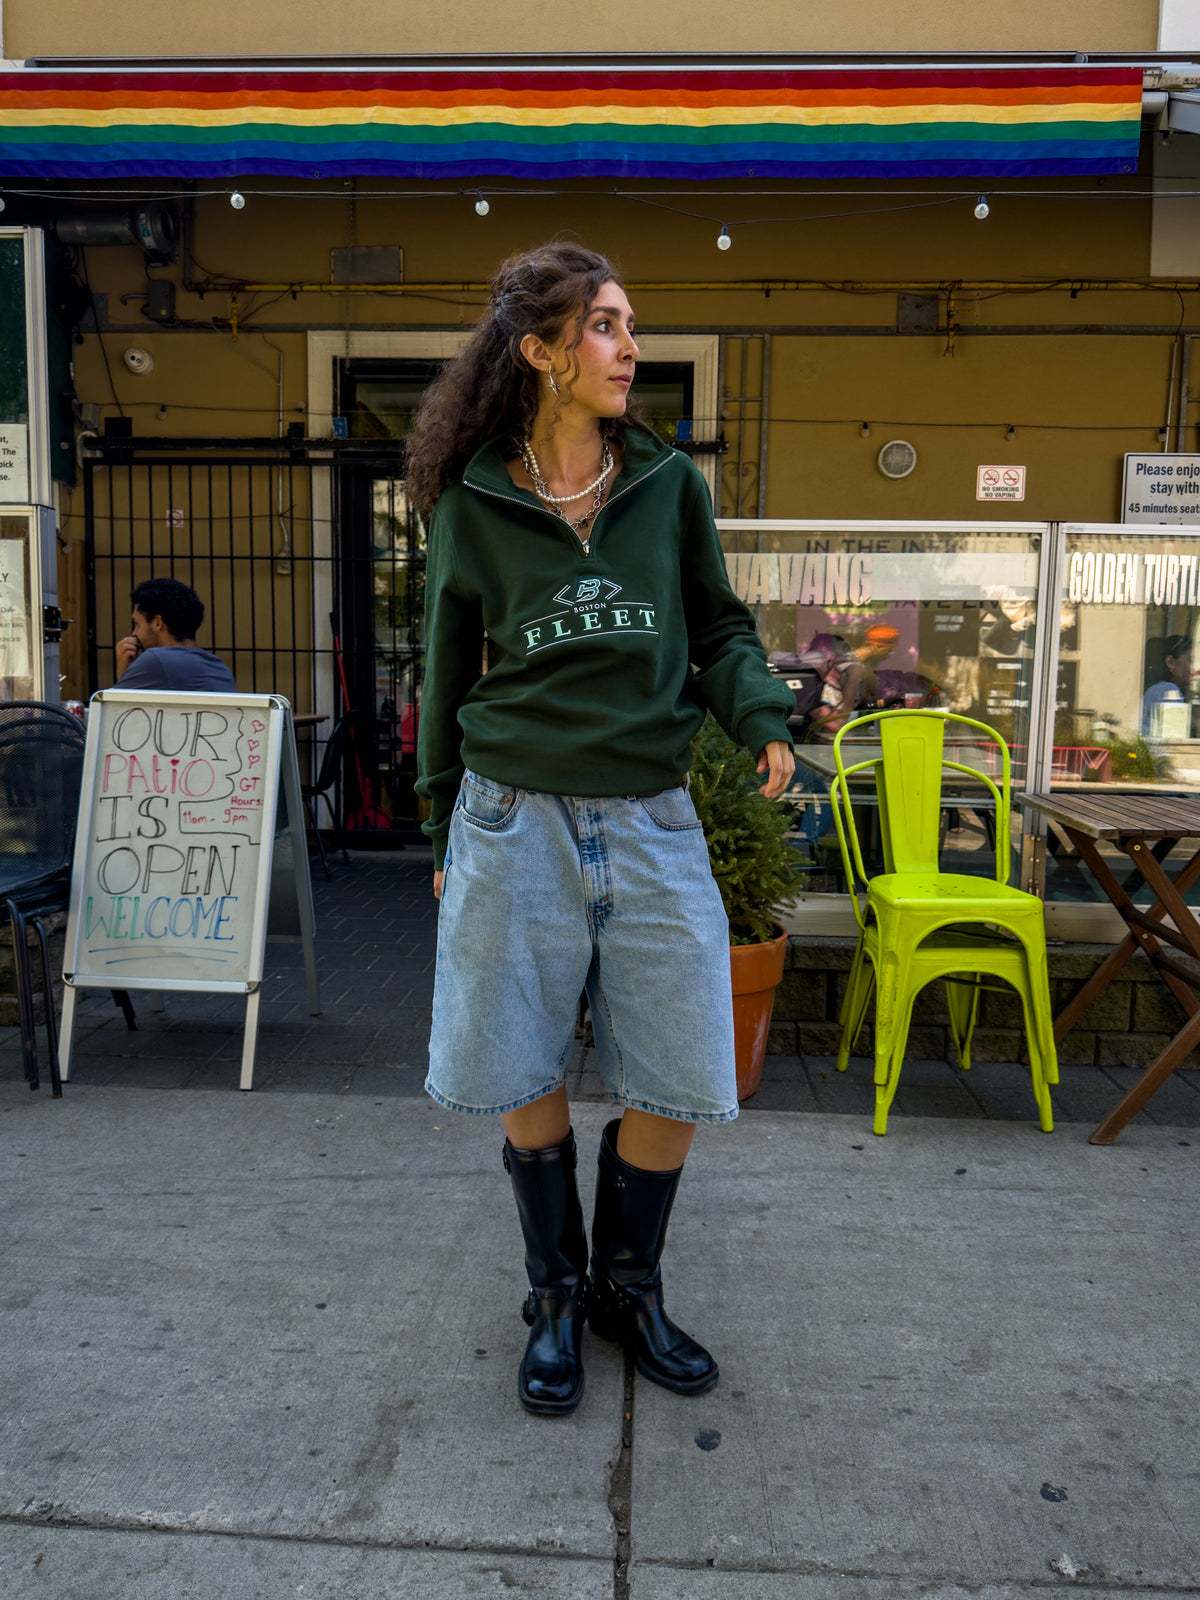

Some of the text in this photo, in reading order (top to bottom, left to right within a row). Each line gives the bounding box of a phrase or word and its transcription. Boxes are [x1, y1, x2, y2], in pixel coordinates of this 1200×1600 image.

[1136, 463, 1173, 475] Please
[1150, 482, 1199, 496] stay with
[1128, 503, 1140, 513] 45
[1143, 504, 1178, 514] minutes
[806, 540, 830, 553] IN
[841, 540, 890, 553] THE
[777, 552, 873, 606] VANG
[1069, 552, 1200, 606] GOLDEN TURTL
[574, 602, 607, 613] BOSTON
[523, 609, 655, 649] FLEET
[112, 707, 229, 762] OUR
[96, 795, 169, 842] IS
[97, 844, 241, 895] OPEN
[84, 896, 239, 940] WELCOME
